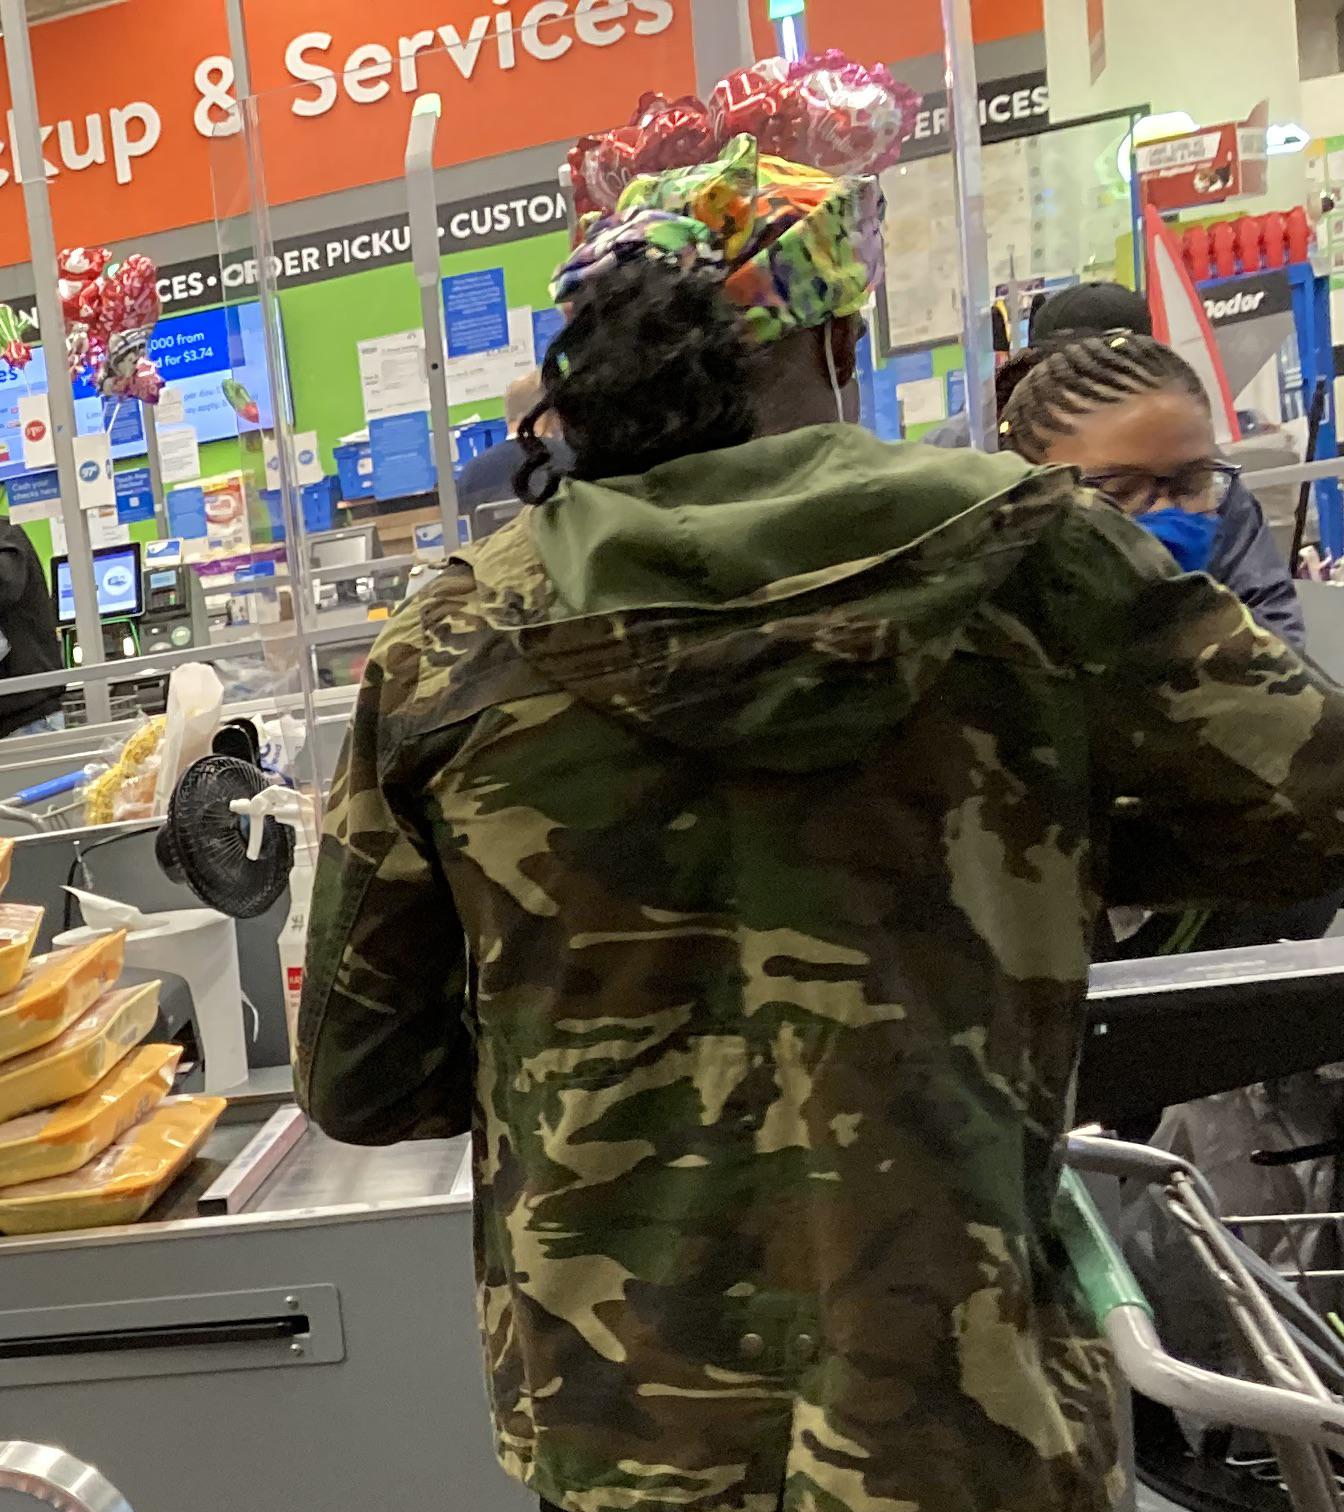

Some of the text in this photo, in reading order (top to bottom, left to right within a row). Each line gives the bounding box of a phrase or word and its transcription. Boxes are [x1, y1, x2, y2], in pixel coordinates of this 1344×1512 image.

[193, 55, 243, 138] &
[284, 0, 674, 118] Services
[220, 226, 413, 289] ORDER PICKU
[164, 348, 182, 366] for
[176, 331, 205, 347] from
